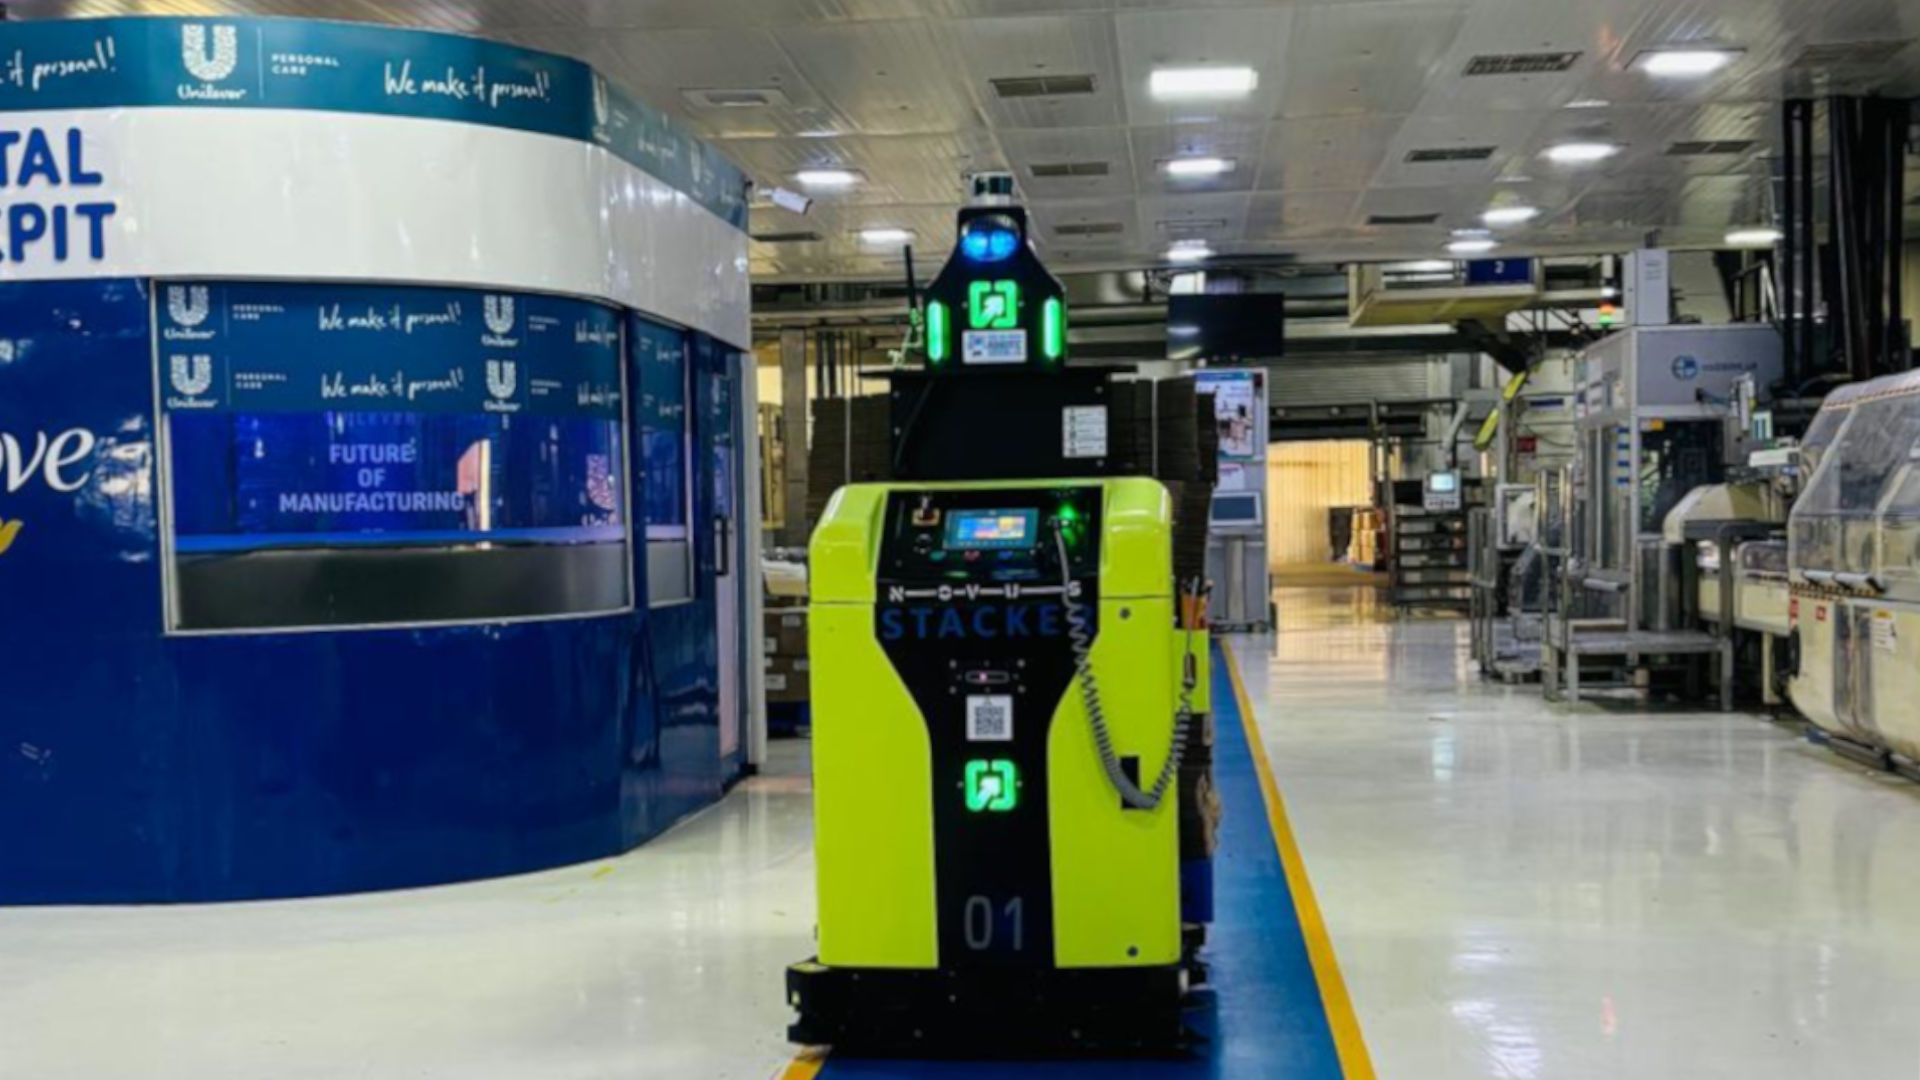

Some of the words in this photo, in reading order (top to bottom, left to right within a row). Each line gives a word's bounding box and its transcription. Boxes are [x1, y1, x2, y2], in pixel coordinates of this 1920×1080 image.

[6, 50, 24, 87] it
[32, 36, 117, 91] personal!
[271, 53, 340, 67] PERSONAL
[177, 83, 247, 100] Unilever
[385, 59, 418, 95] We
[421, 66, 469, 99] make
[472, 65, 485, 101] it
[490, 71, 551, 109] personal!
[0, 202, 117, 263] PIT
[318, 303, 345, 331] We
[347, 306, 387, 331] make
[405, 301, 462, 334] personal!
[321, 371, 347, 399] We
[350, 374, 389, 398] make
[408, 366, 464, 400] personal!
[0, 427, 95, 493] ve
[329, 443, 416, 463] FUTURE
[357, 469, 386, 488] OF
[279, 491, 464, 513] MANUFACTURING
[964, 895, 1024, 951] 01
